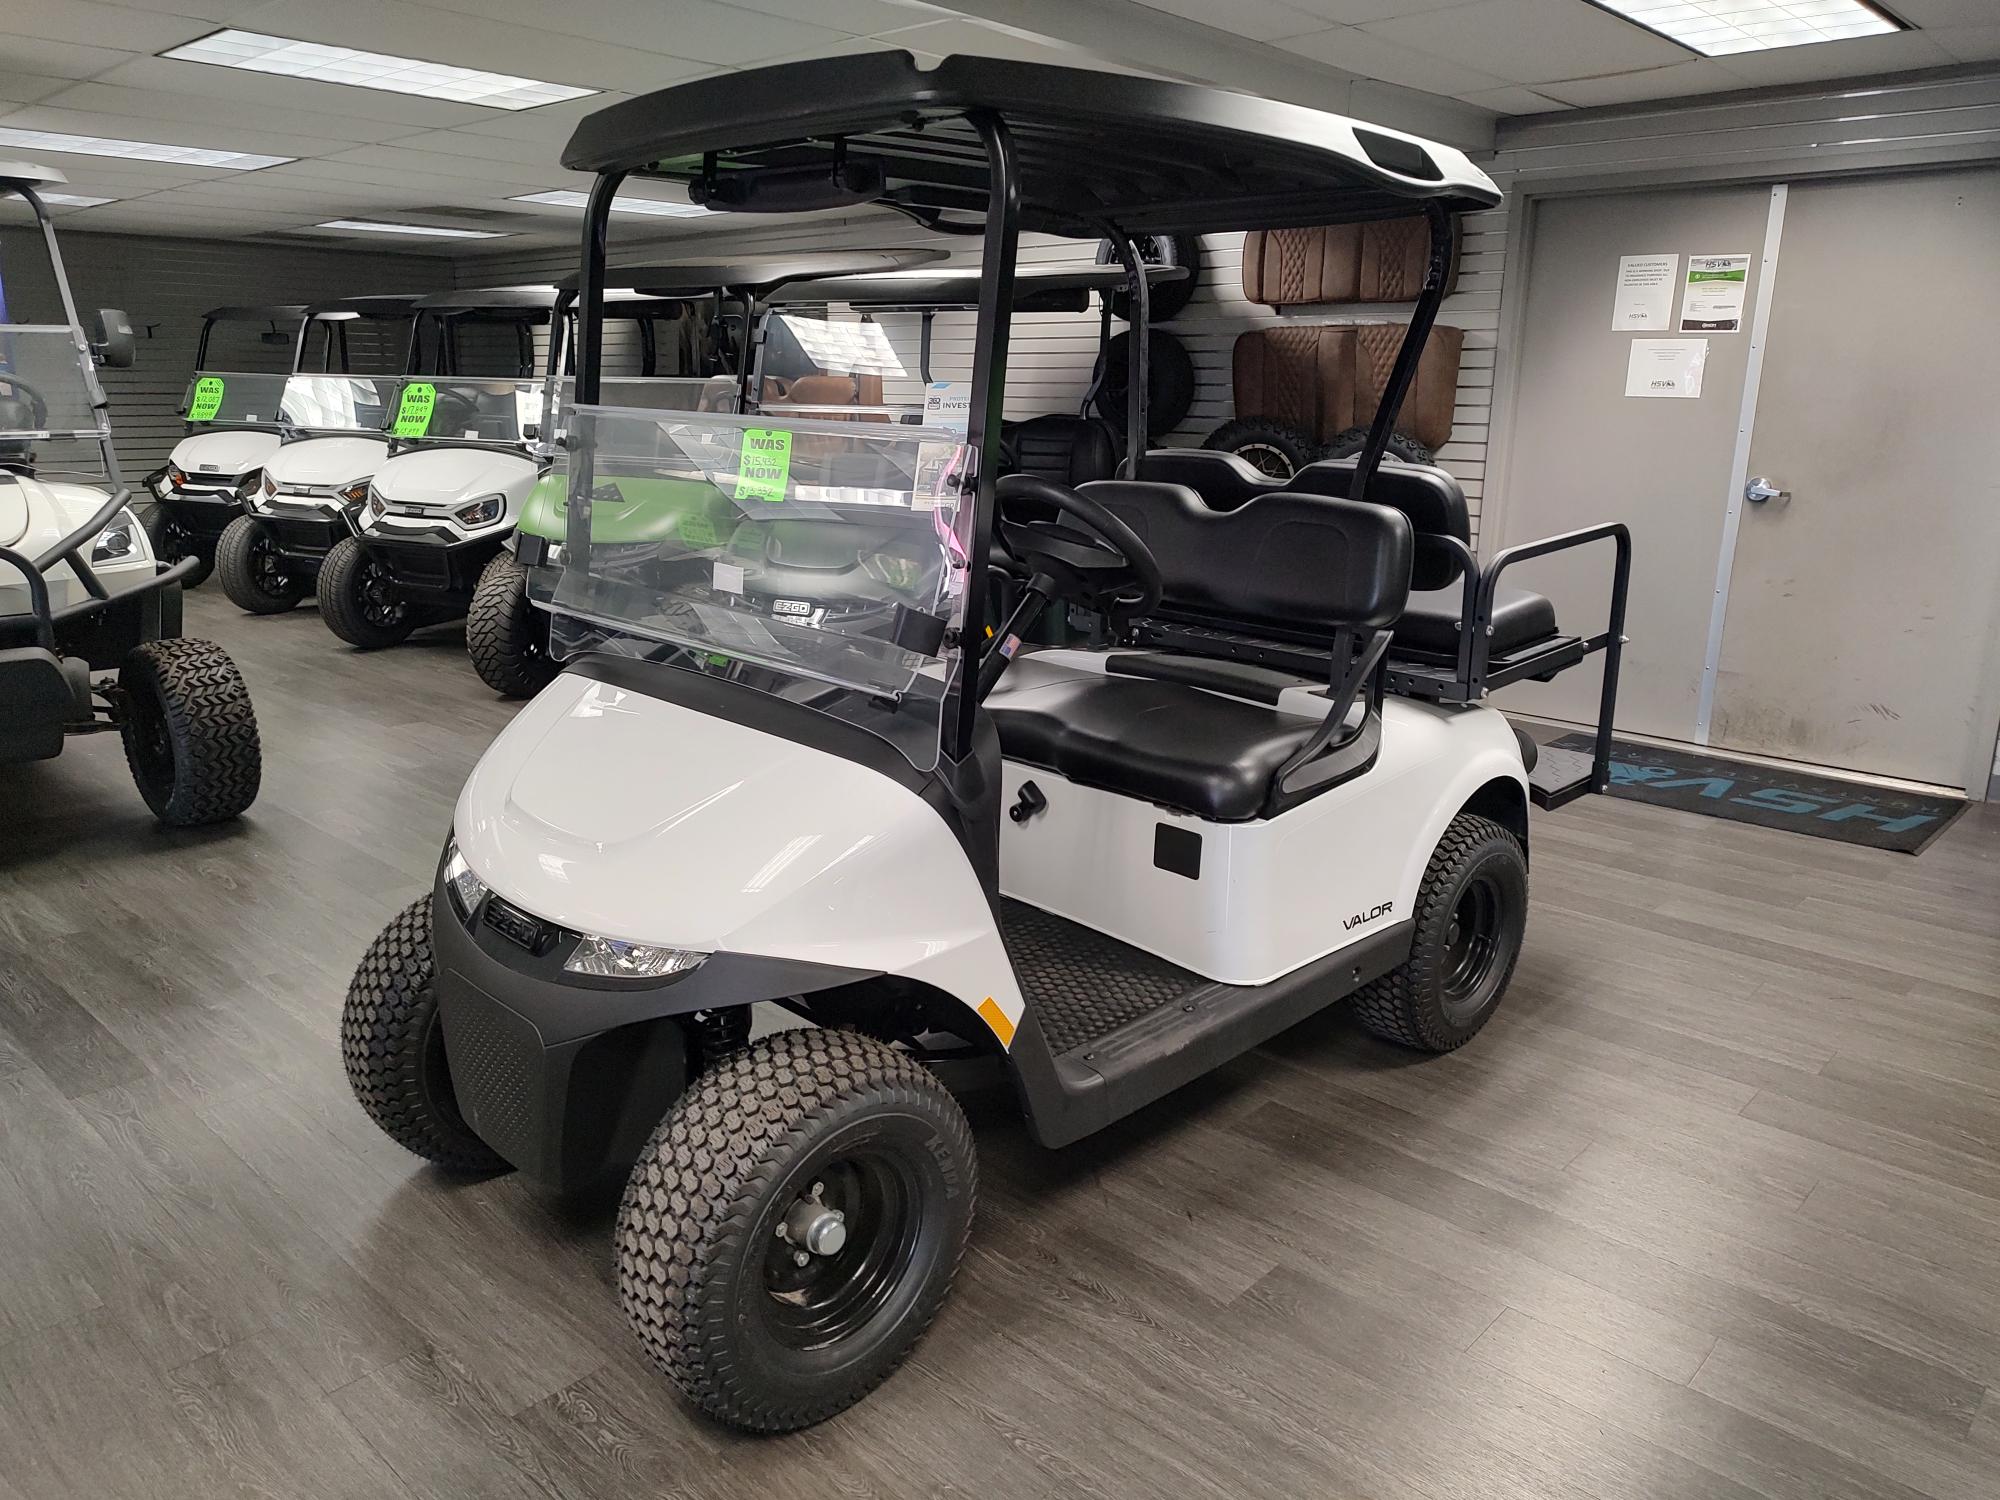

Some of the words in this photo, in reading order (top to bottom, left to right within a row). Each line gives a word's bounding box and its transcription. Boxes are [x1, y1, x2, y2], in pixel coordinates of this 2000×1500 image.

[407, 394, 430, 403] WAS
[400, 415, 426, 423] NOW
[750, 438, 785, 451] WAS
[744, 467, 783, 480] NOW
[1648, 777, 1941, 833] HSV
[1342, 901, 1393, 930] VALOR
[924, 1134, 960, 1201] KENDA
